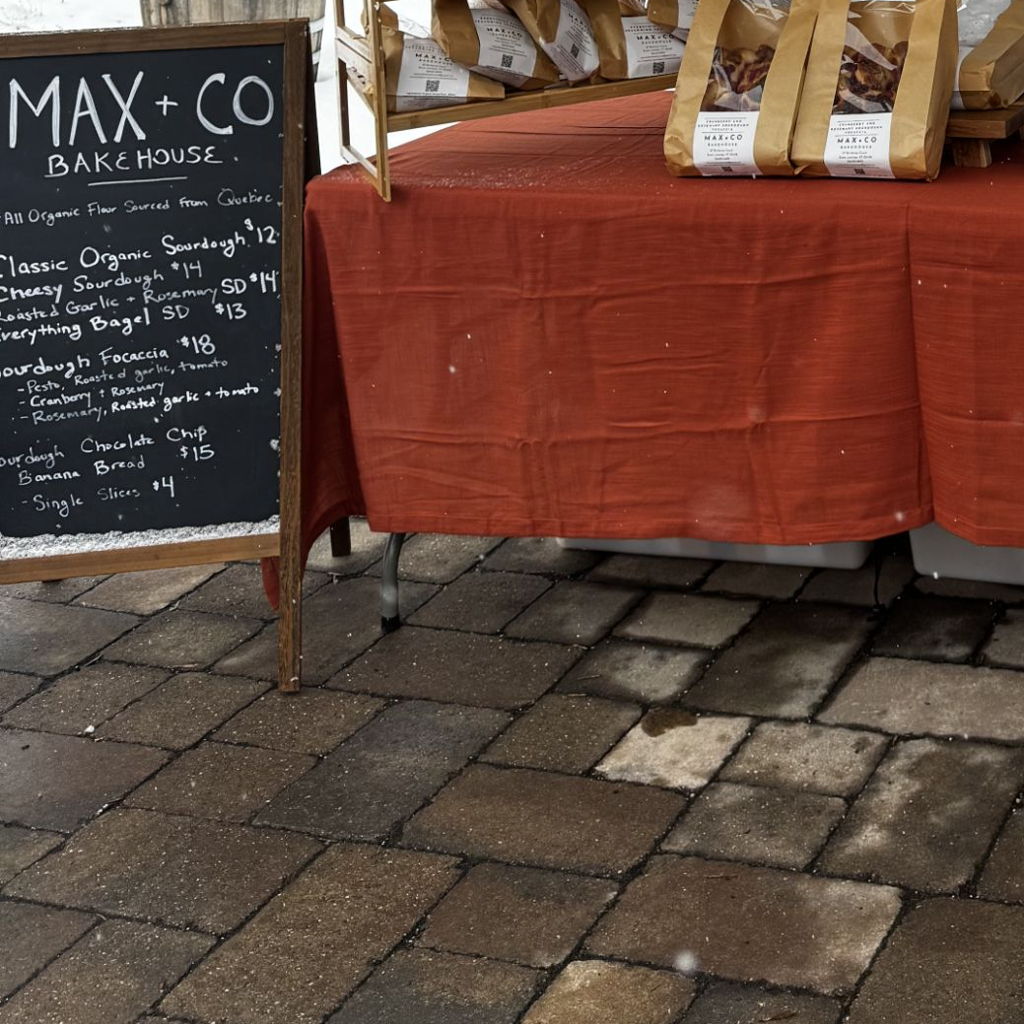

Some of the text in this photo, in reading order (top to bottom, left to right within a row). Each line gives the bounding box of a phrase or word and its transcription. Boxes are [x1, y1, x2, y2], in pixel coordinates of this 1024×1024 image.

[9, 71, 146, 149] MAX
[196, 73, 274, 135] CO
[46, 146, 223, 176] BAKEHOUSE
[4, 211, 24, 225] All
[28, 207, 80, 226] Organic
[124, 198, 170, 213] Sourced
[80, 246, 152, 271] Organic
[161, 231, 246, 257] Sourdough
[66, 295, 119, 315] Garlic
[143, 288, 217, 304] Rosemary
[221, 279, 247, 295] SD
[249, 271, 277, 293] $14
[73, 271, 164, 292] Sourdough
[171, 260, 202, 280] $14
[0, 302, 247, 345] verything Bagel SD $13
[0, 334, 215, 379] ourdough Focaccia $18
[75, 368, 126, 386] Roasted
[179, 358, 228, 372] tomato
[111, 382, 164, 397] Rosemary
[111, 398, 155, 413] Roasted
[164, 392, 199, 411] garlic
[215, 383, 259, 399] tomato
[0, 426, 207, 469] ourdough Chocolate Chip
[19, 445, 215, 486] Banana Bread $15
[33, 476, 175, 517] Single Slices $4
